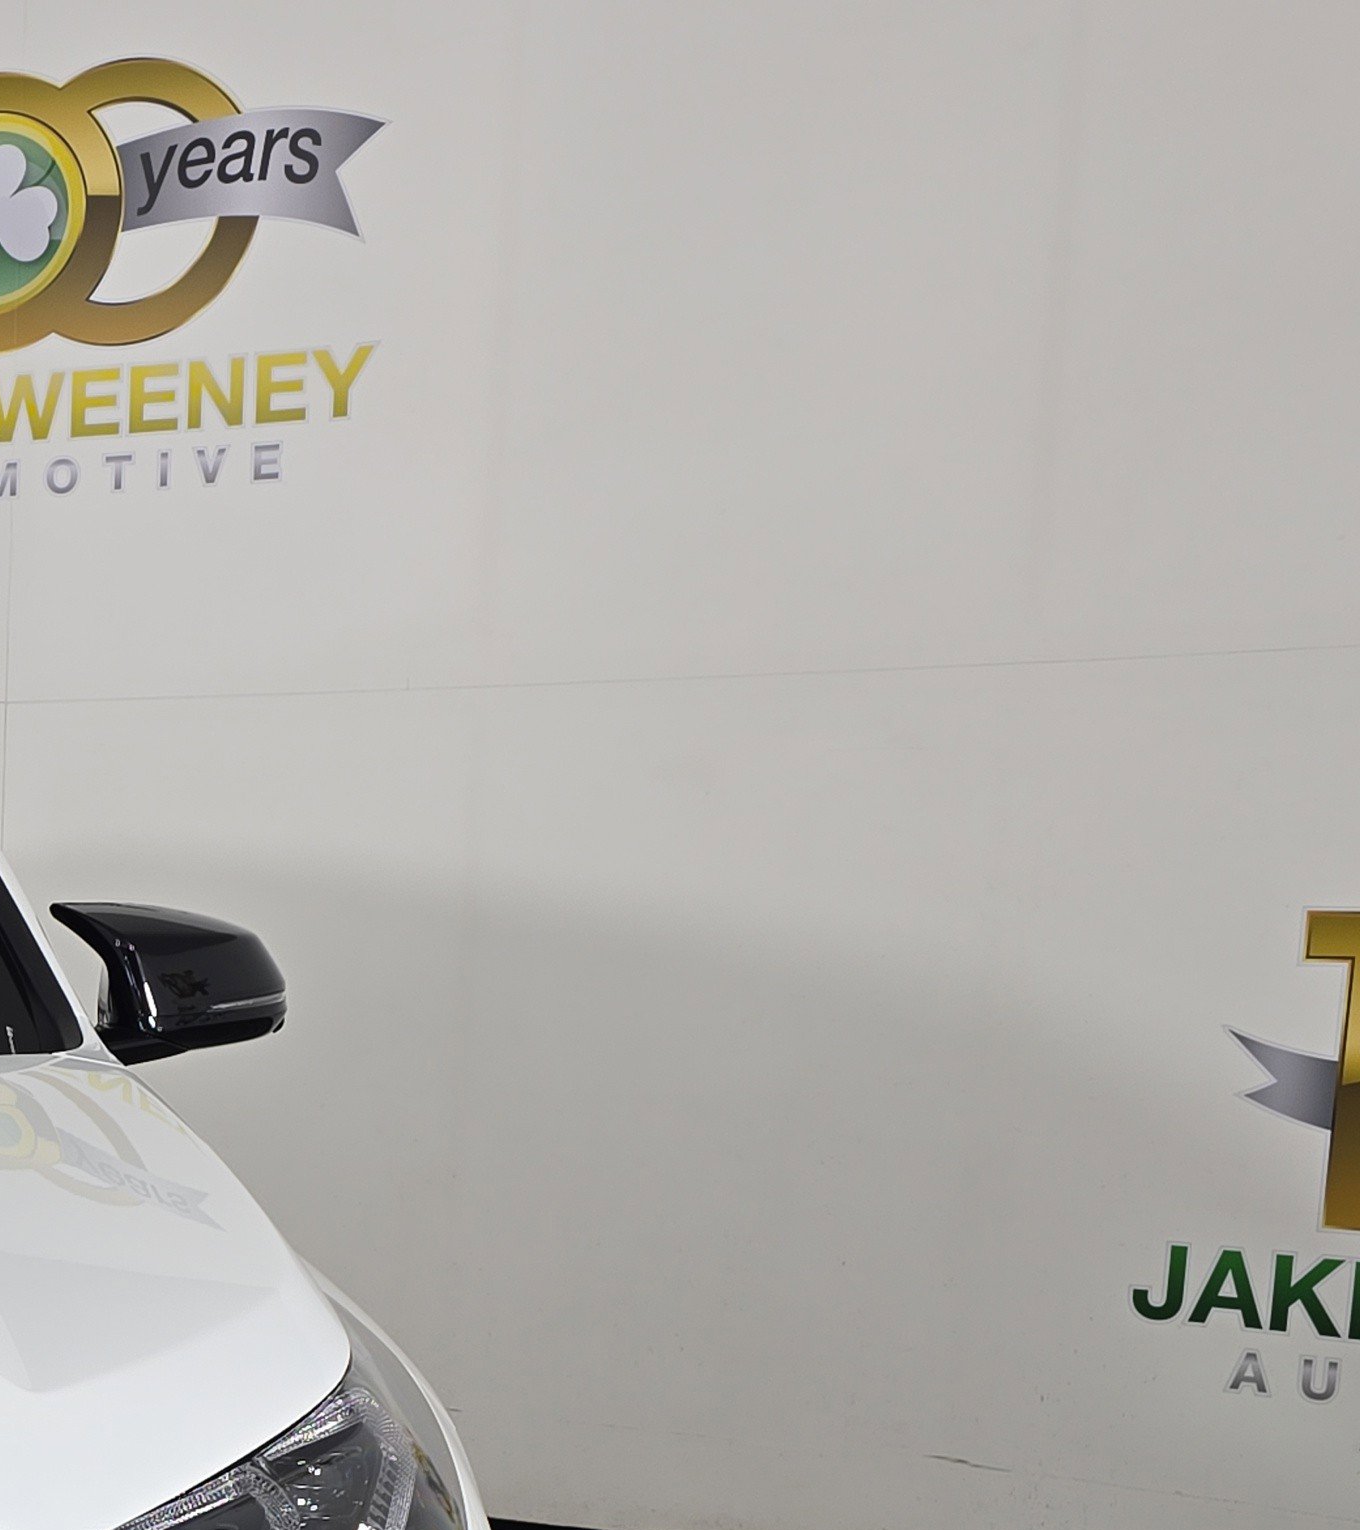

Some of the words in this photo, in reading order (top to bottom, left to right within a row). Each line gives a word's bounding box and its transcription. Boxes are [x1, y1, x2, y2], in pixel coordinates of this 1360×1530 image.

[135, 119, 322, 217] years
[1132, 1245, 1360, 1340] JAK
[1229, 1352, 1339, 1401] AU
